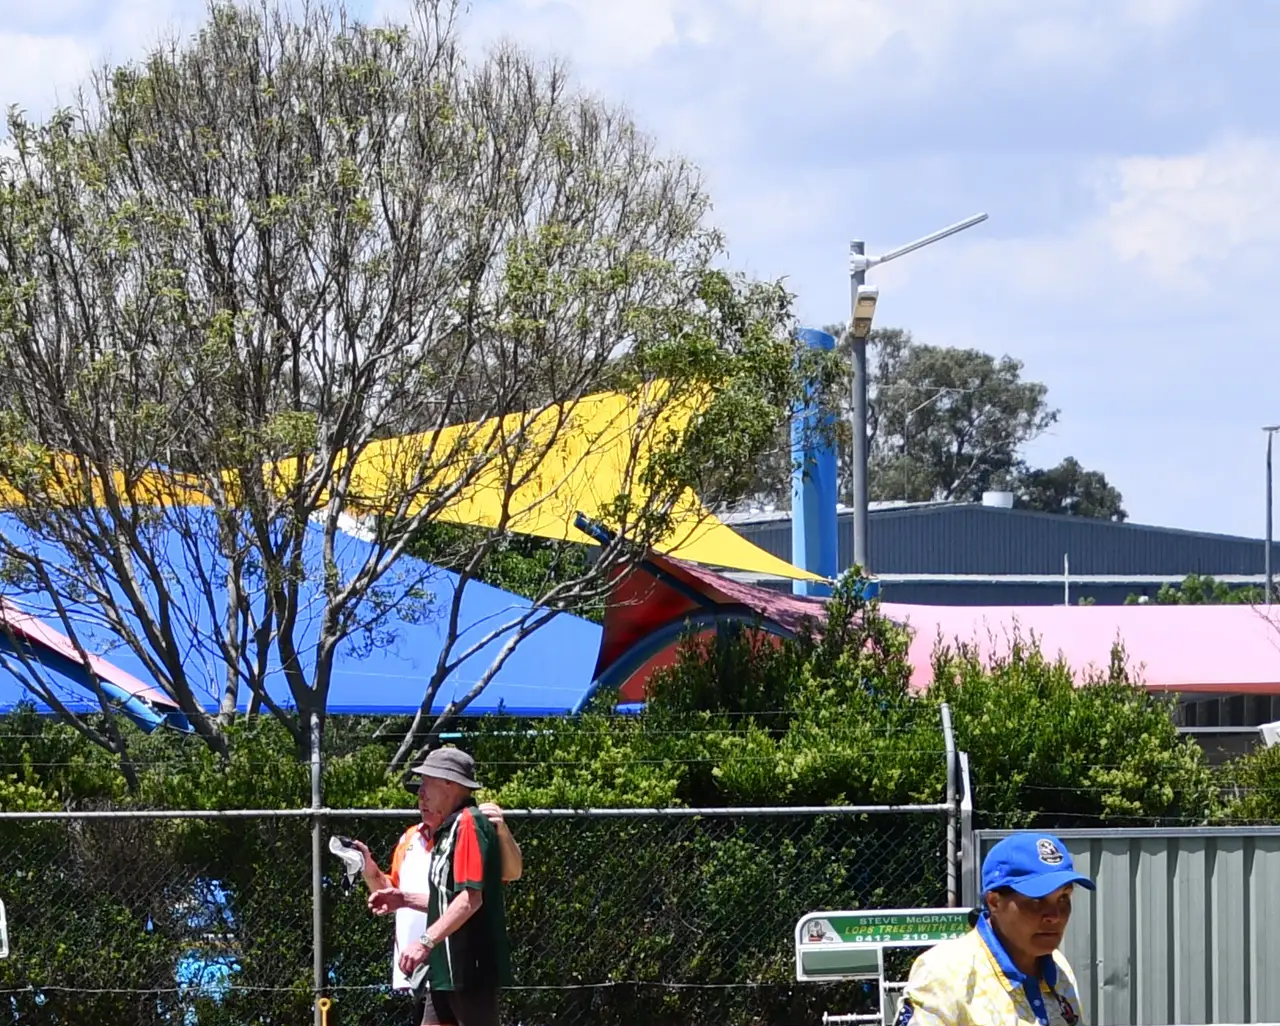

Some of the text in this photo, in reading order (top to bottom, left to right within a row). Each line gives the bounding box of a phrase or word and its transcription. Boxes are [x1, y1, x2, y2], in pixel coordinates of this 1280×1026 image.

[859, 915, 962, 925] STEVE McGRATH
[844, 923, 971, 935] LOPS TREES WITH EAS
[856, 934, 891, 942] 0412
[902, 933, 929, 941] 210
